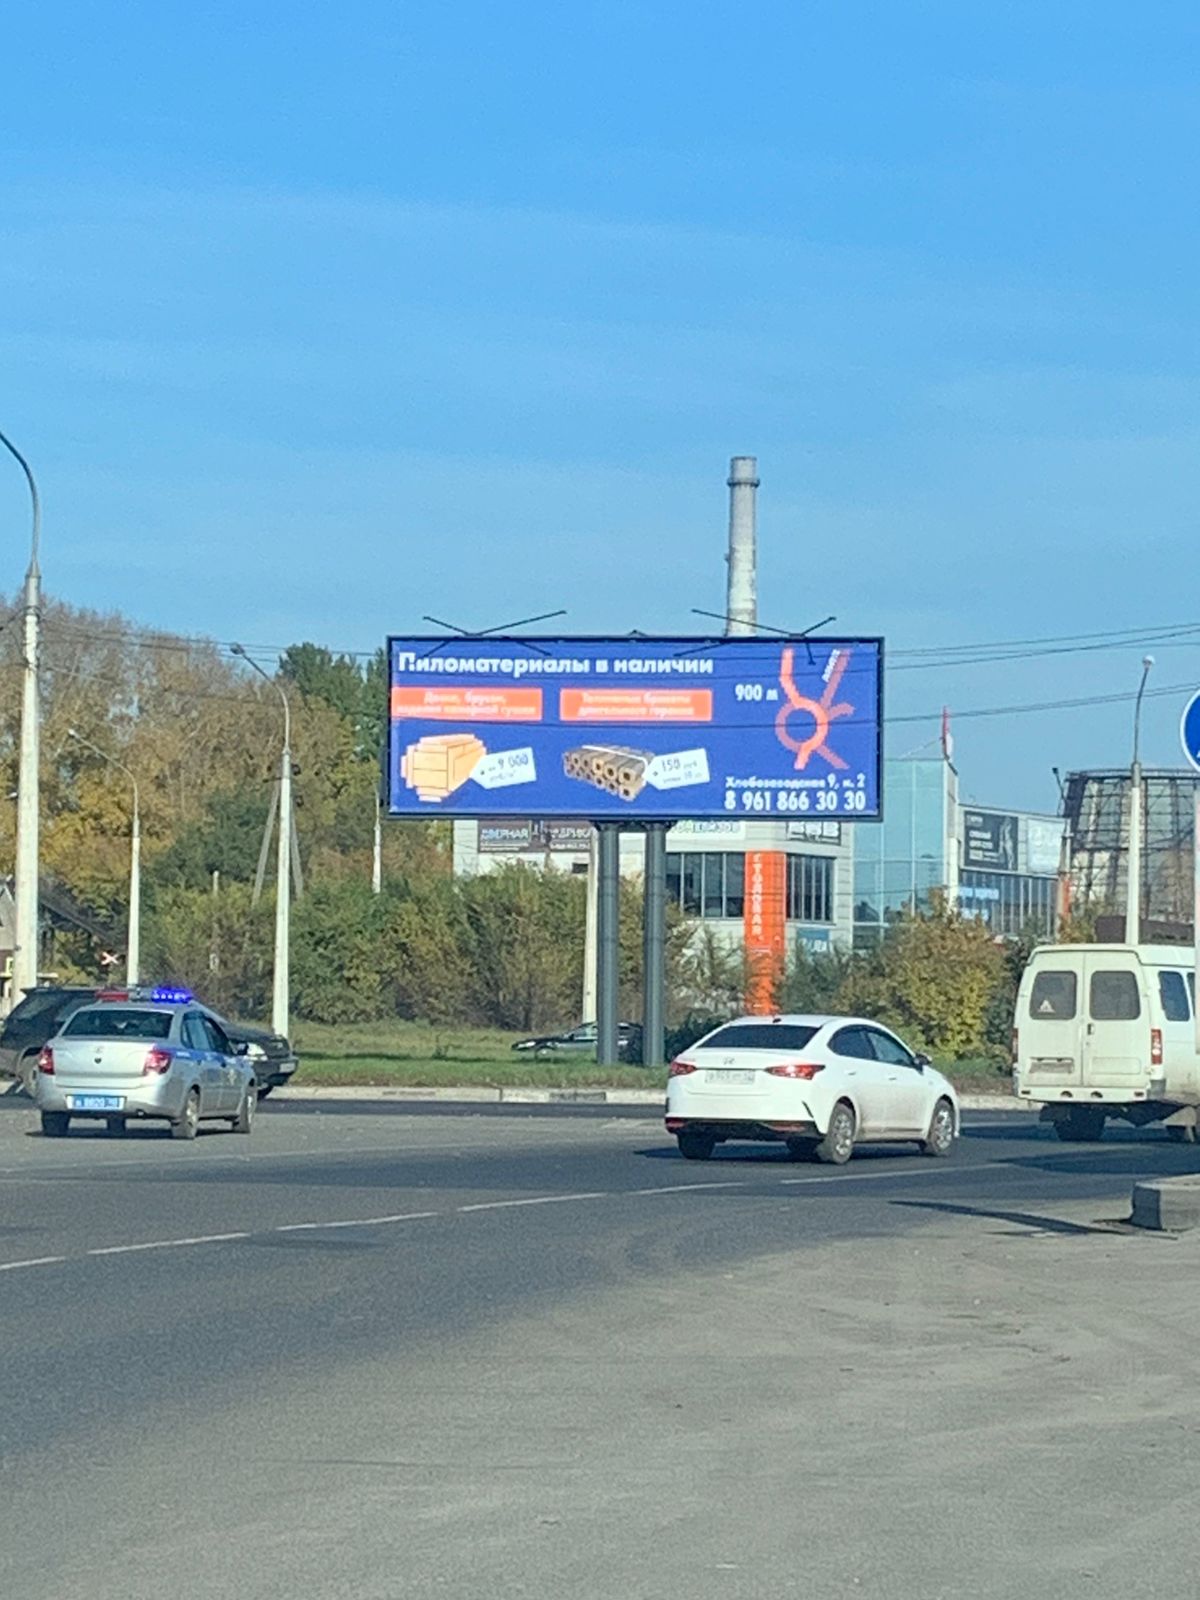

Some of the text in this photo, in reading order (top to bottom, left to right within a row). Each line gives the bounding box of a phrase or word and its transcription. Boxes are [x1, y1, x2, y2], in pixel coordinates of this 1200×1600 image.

[398, 651, 714, 678] Пиломатериалы в наличии
[735, 684, 778, 701] 900 м
[660, 757, 681, 772] 150
[857, 773, 866, 788] 2
[724, 790, 866, 811] 8 961 866 30 30
